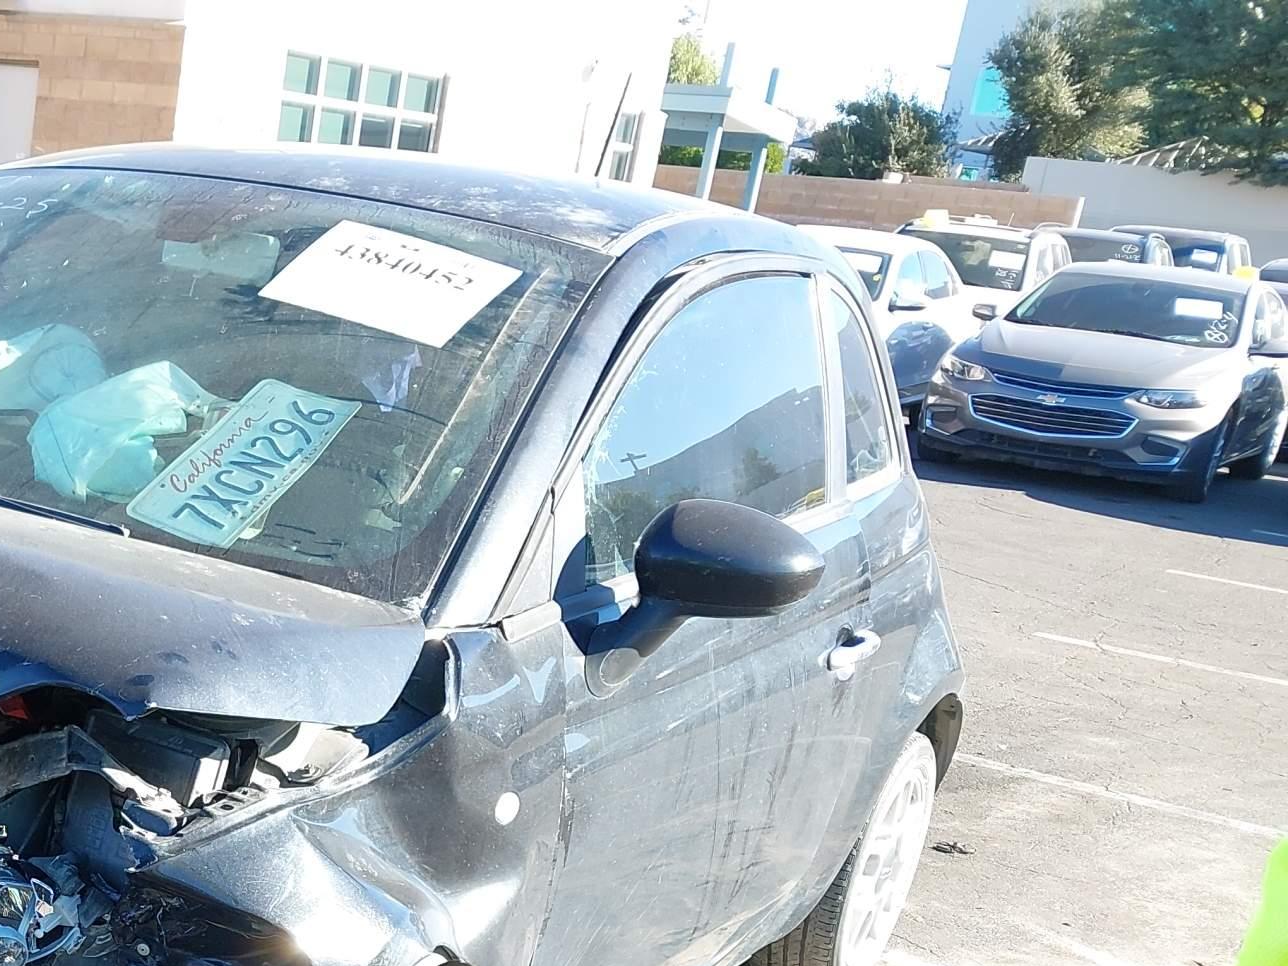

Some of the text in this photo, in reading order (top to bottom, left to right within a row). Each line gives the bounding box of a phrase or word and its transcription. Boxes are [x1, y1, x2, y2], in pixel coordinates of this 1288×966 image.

[334, 244, 475, 291] 43840452
[169, 410, 270, 494] California
[172, 400, 336, 531] 7XCN296
